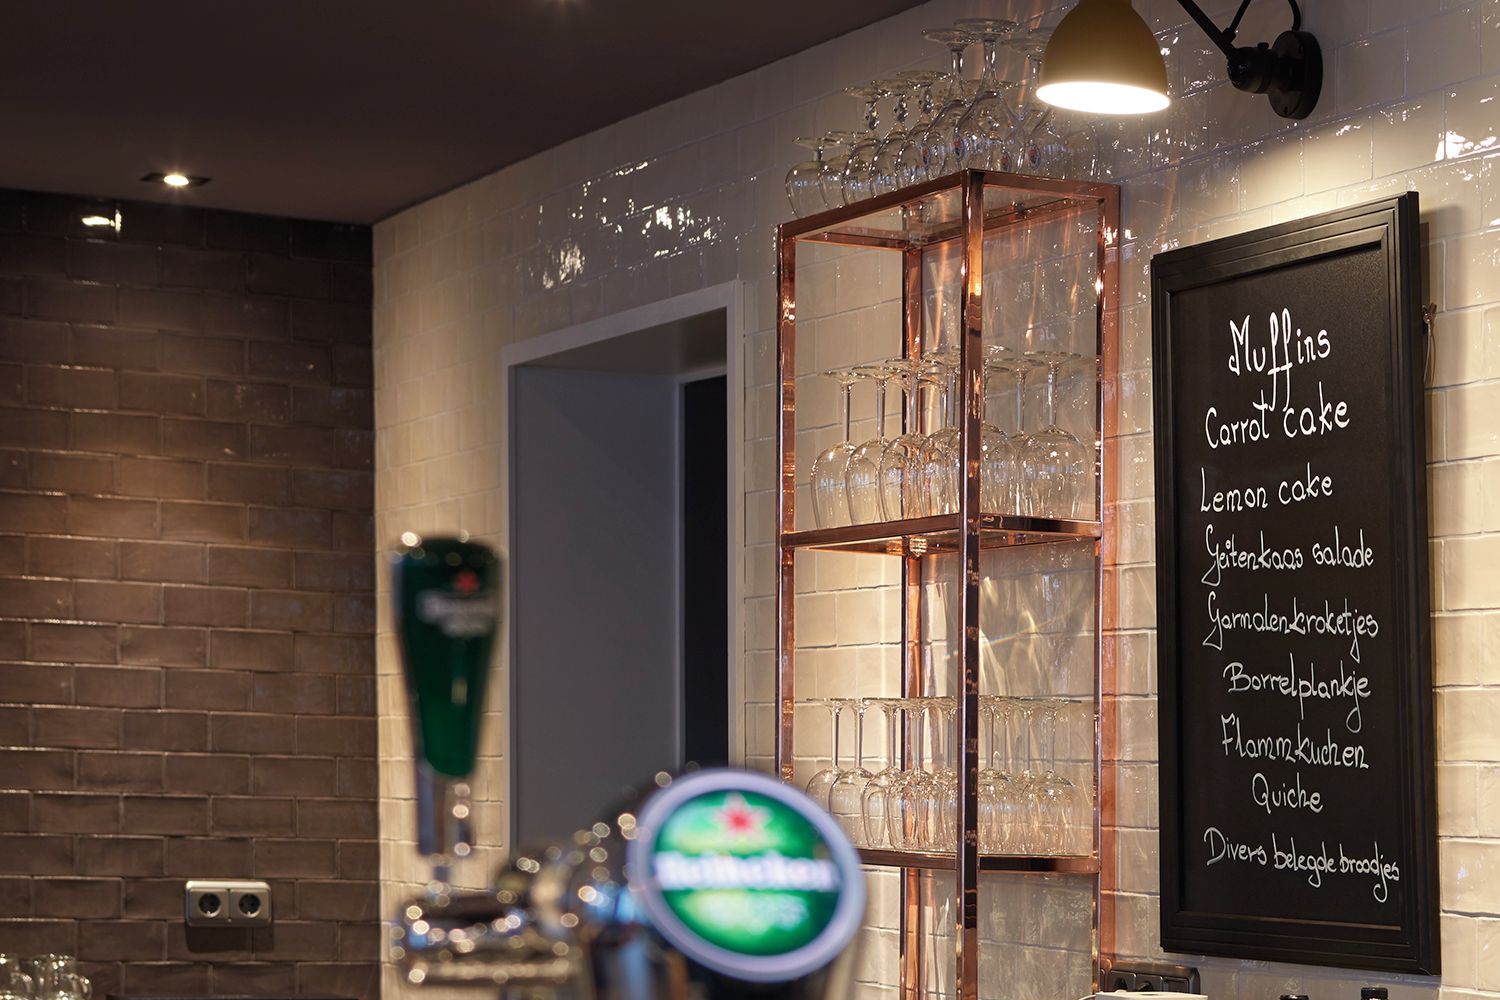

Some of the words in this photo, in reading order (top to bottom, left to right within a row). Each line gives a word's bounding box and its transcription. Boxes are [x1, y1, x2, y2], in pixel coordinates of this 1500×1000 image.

[1228, 308, 1331, 412] Muffins
[1205, 389, 1270, 449] Carrot
[1283, 381, 1351, 438] cake
[1200, 467, 1269, 513] Lemon
[1278, 462, 1333, 505] cake
[1201, 523, 1304, 586] Geitenkaas
[1311, 525, 1375, 568] salade
[1201, 590, 1379, 664] Garnalenkroketjes
[1222, 652, 1372, 733] Borrelplankje
[1220, 713, 1369, 769] Flammkuchen
[1252, 772, 1324, 814] Quiche
[1203, 826, 1268, 866] Divers
[1272, 832, 1338, 888] belegde
[1339, 841, 1400, 902] broodjes
